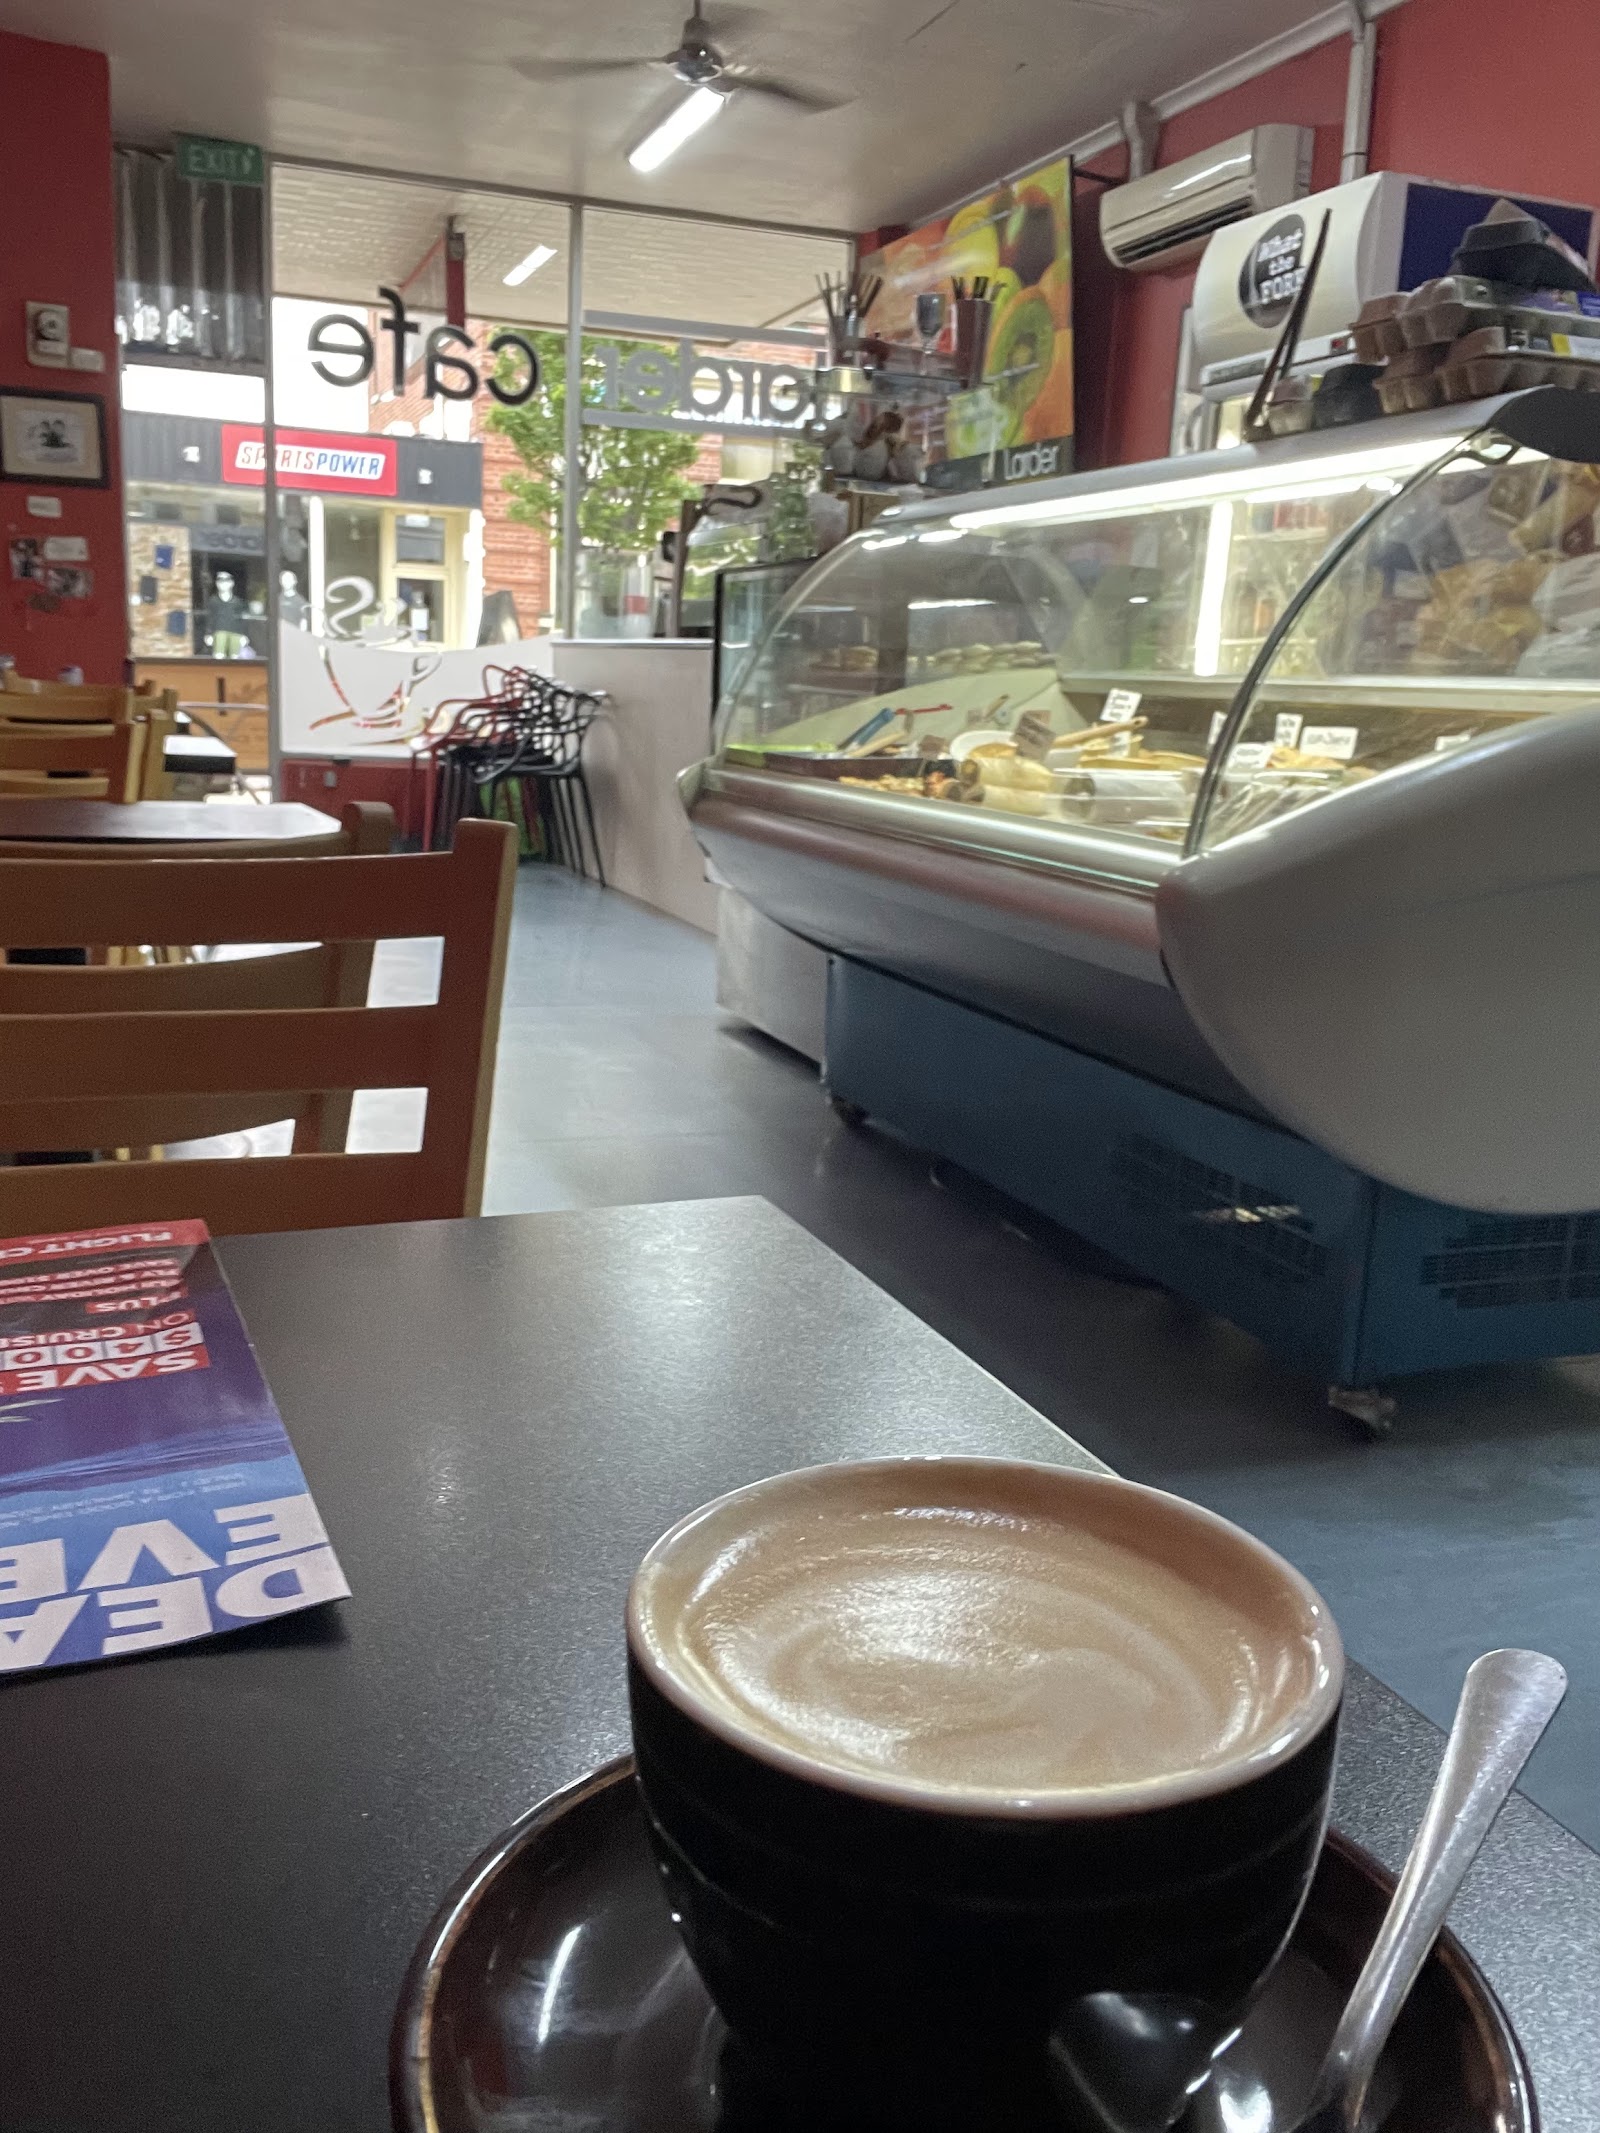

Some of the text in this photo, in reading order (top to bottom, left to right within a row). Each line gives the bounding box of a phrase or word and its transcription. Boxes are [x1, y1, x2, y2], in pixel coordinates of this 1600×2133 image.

[188, 143, 238, 175] EXIT
[241, 446, 380, 476] SPRTSPOWER
[39, 1231, 172, 1253] FLIGHT
[137, 1313, 190, 1334] ON
[16, 1350, 198, 1392] SAVE
